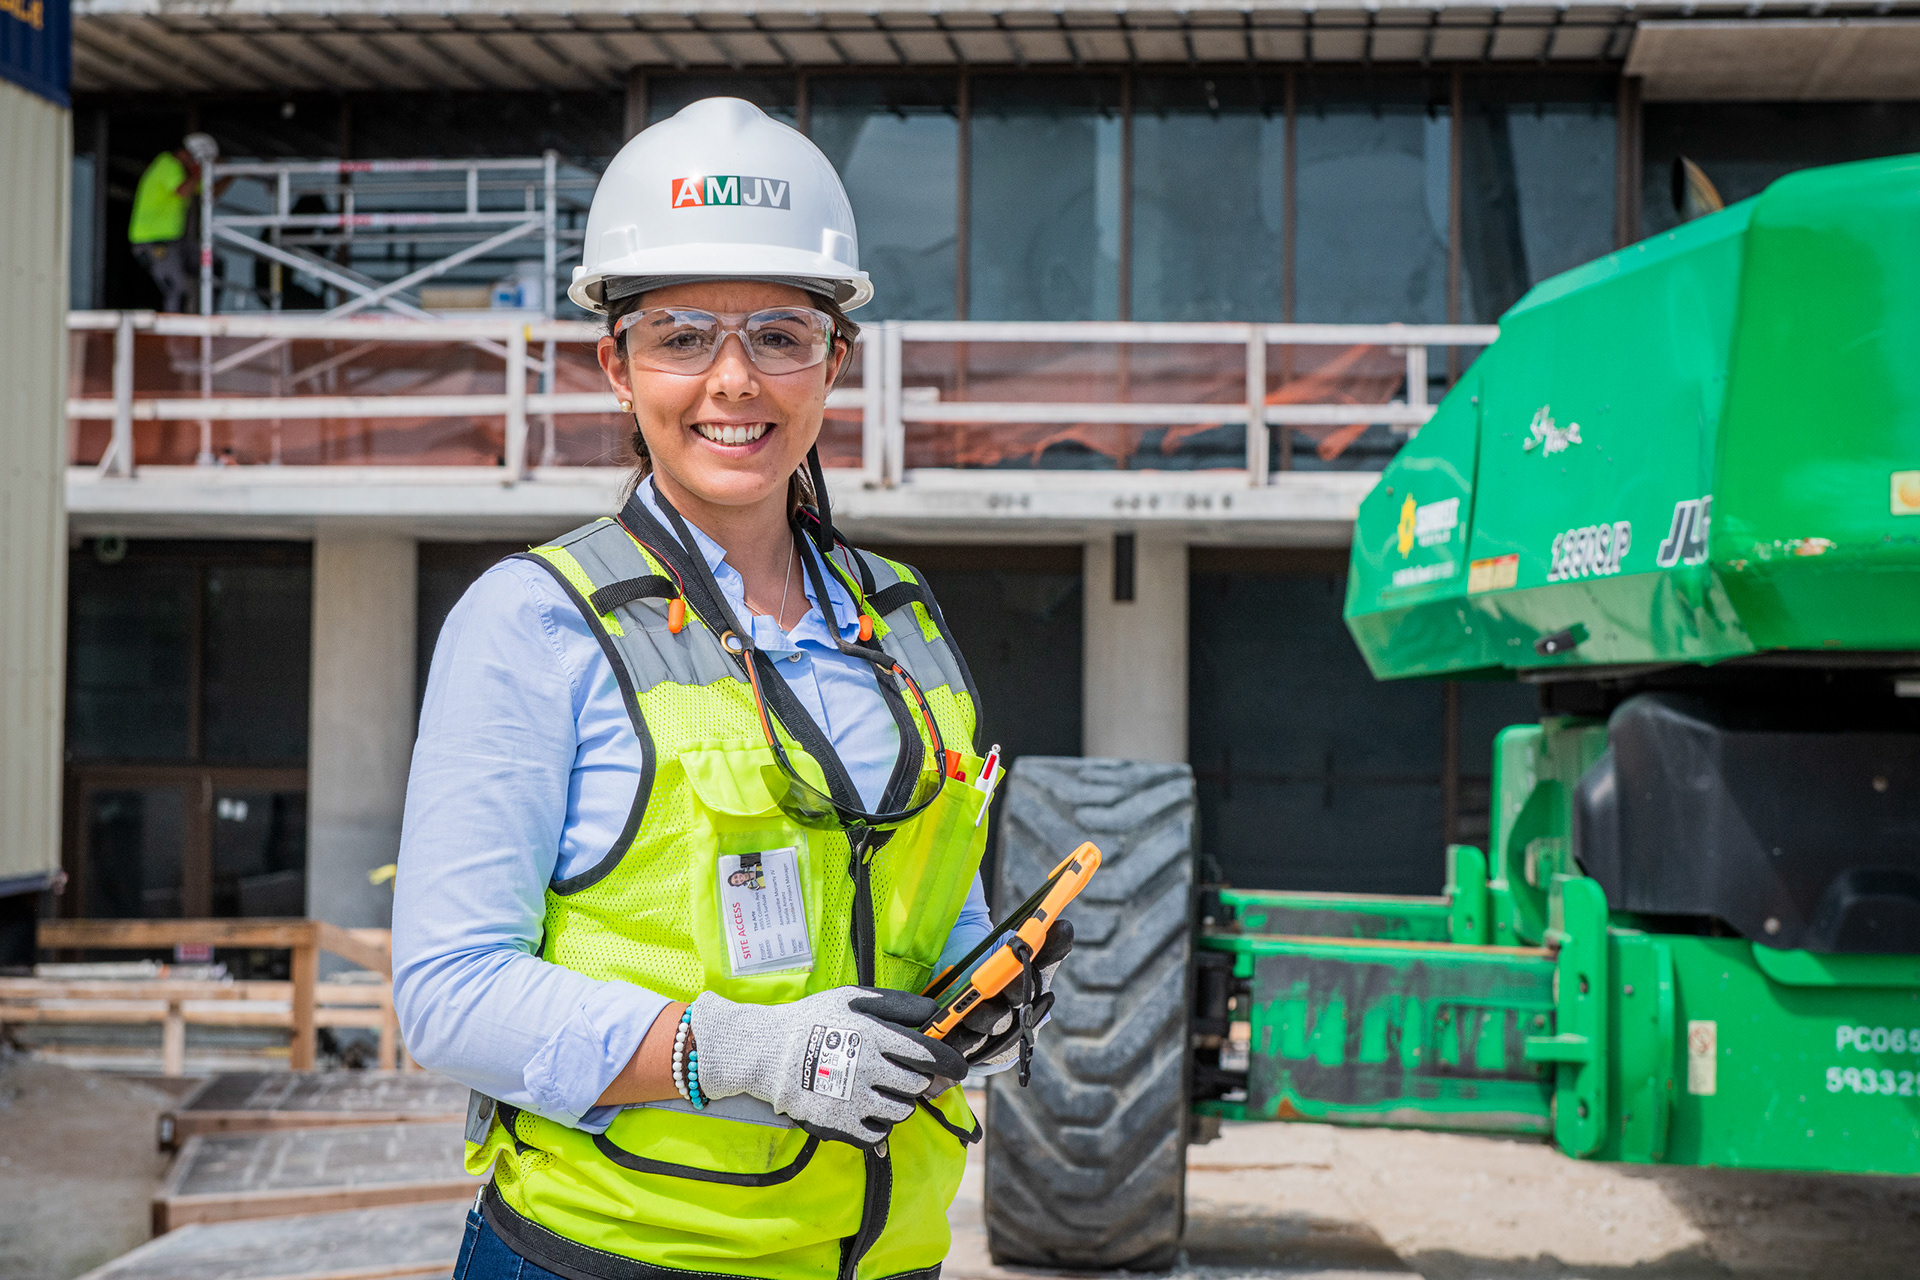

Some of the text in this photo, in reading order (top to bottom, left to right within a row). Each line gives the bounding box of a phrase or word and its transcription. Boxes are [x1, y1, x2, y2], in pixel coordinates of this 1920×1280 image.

[673, 176, 788, 207] AMJV
[732, 901, 752, 960] SITE ACCESS
[803, 1026, 822, 1089] WORX203
[1826, 1066, 1920, 1097] 59332
